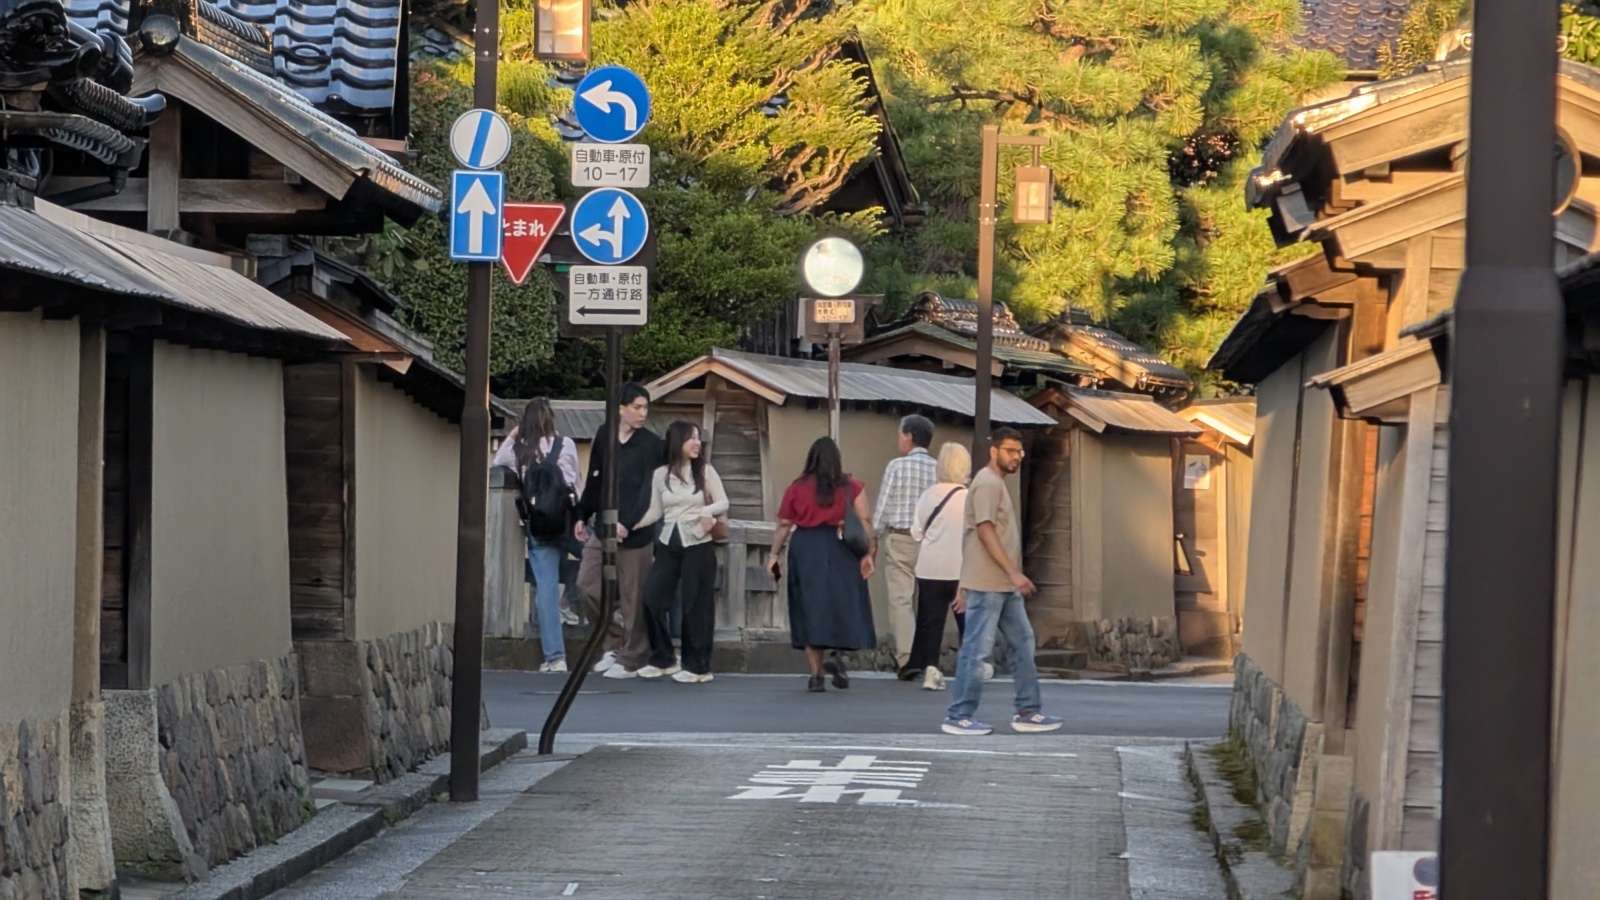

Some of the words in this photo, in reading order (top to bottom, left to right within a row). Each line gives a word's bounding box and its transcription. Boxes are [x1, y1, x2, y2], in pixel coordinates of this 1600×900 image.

[576, 149, 646, 164] 自動車・原付
[574, 273, 642, 285] 自動車・原付
[574, 288, 642, 300] 一方通行路
